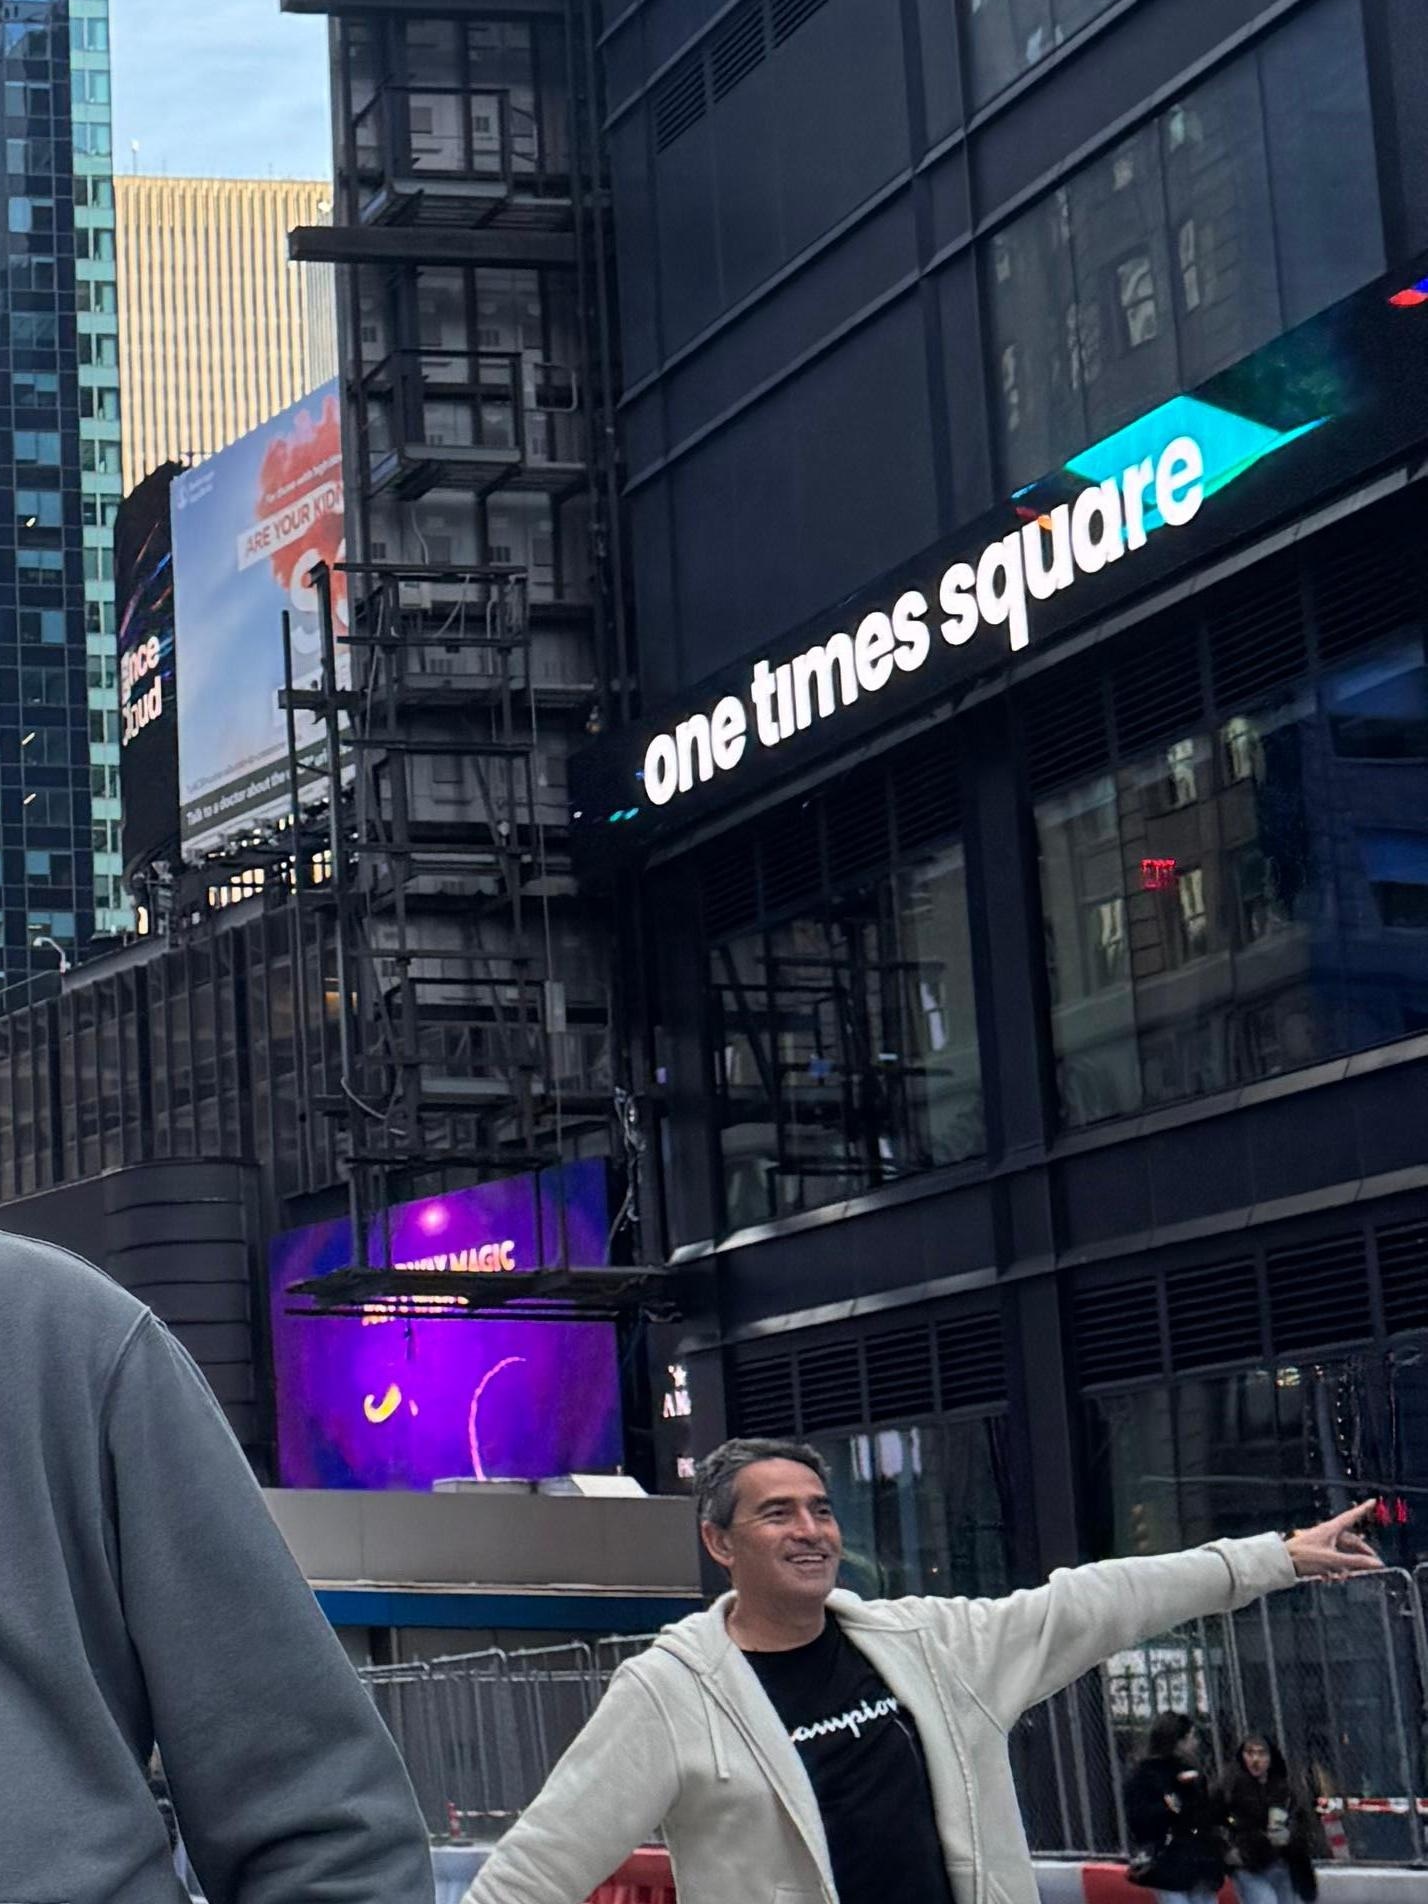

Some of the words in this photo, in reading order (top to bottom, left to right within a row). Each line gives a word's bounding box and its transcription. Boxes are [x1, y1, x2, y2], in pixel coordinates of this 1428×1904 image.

[247, 525, 271, 555] ARE
[273, 503, 311, 540] YOUR
[644, 695, 746, 805] one
[751, 590, 930, 747] times
[939, 435, 1204, 652] square
[449, 1239, 516, 1272] MAGIC
